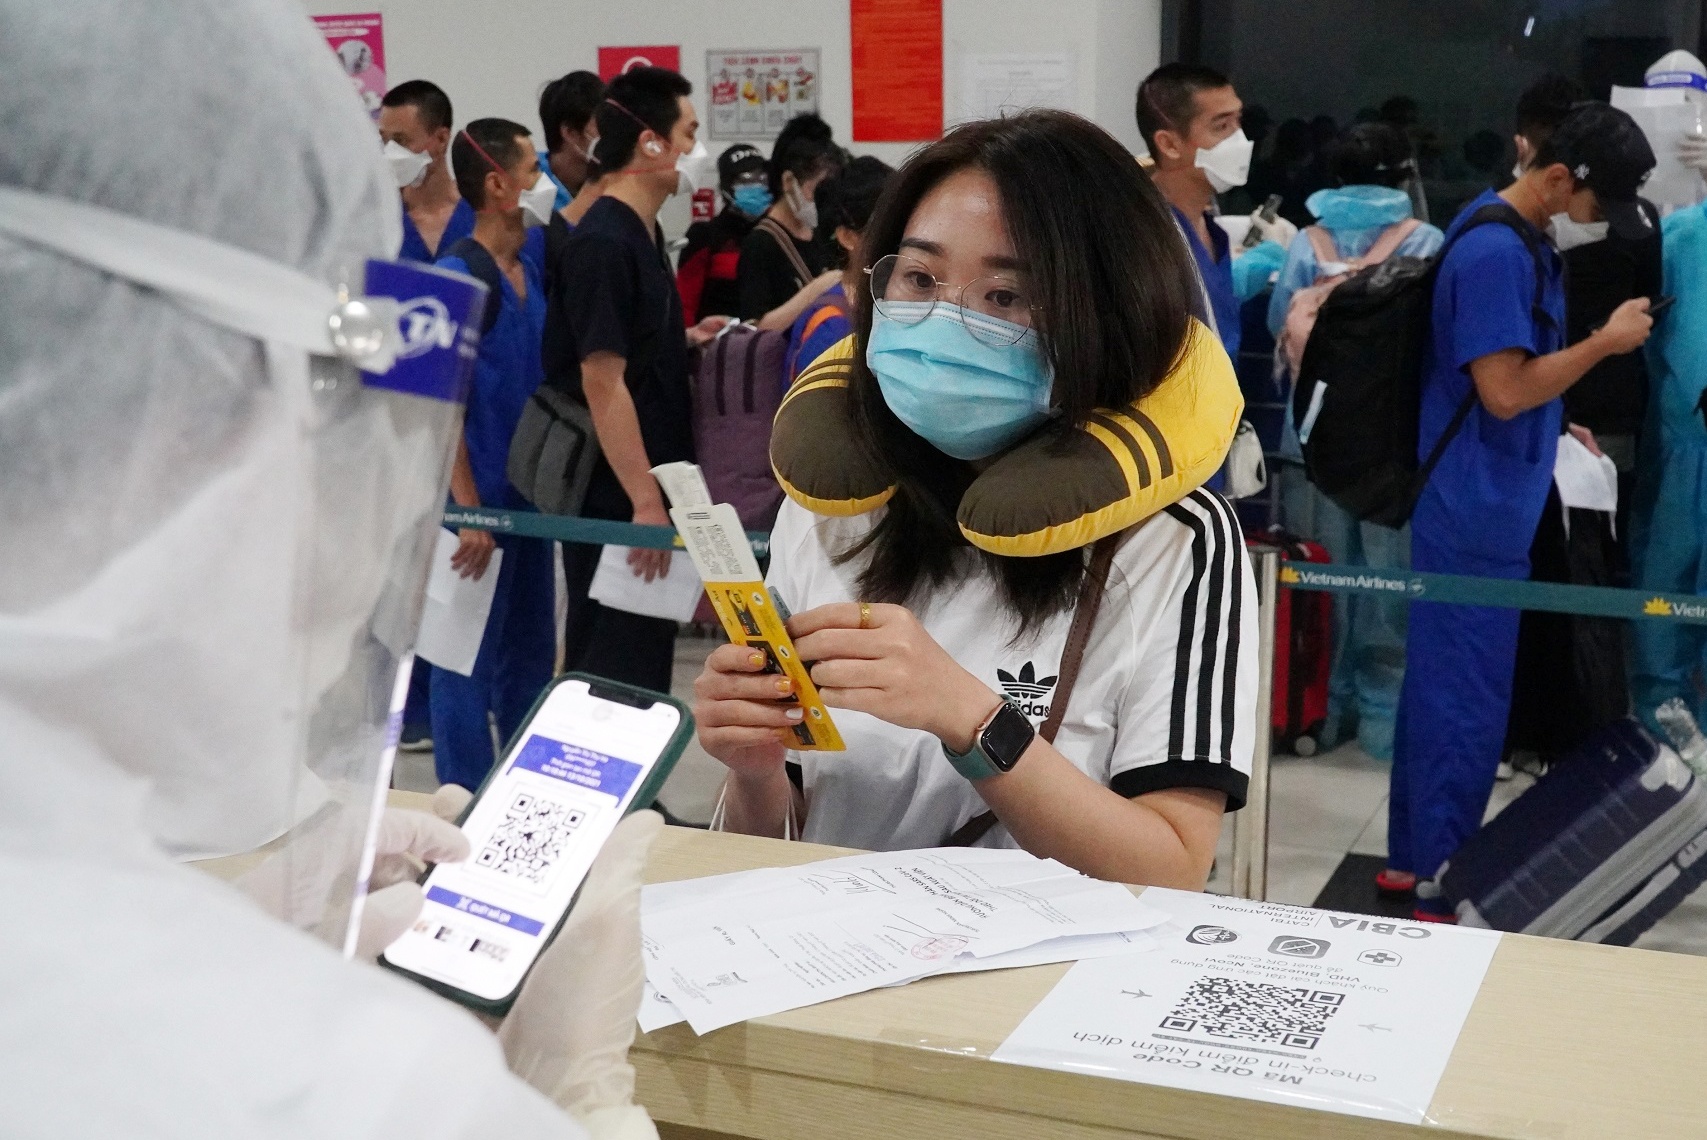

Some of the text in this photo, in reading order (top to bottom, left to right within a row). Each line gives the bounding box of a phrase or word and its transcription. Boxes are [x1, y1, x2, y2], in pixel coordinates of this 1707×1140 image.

[1209, 903, 1314, 921] INTERNATIONAL
[1259, 905, 1317, 916] AIRPORT
[1328, 916, 1432, 939] CBIA
[1226, 953, 1262, 963] Code
[1266, 959, 1289, 968] QR
[1072, 1030, 1124, 1047] dịch
[1131, 1040, 1194, 1057] kiểm
[1198, 1048, 1259, 1066] điểm
[1132, 1052, 1304, 1085] Mã QR Code
[1268, 1059, 1378, 1084] check-in
